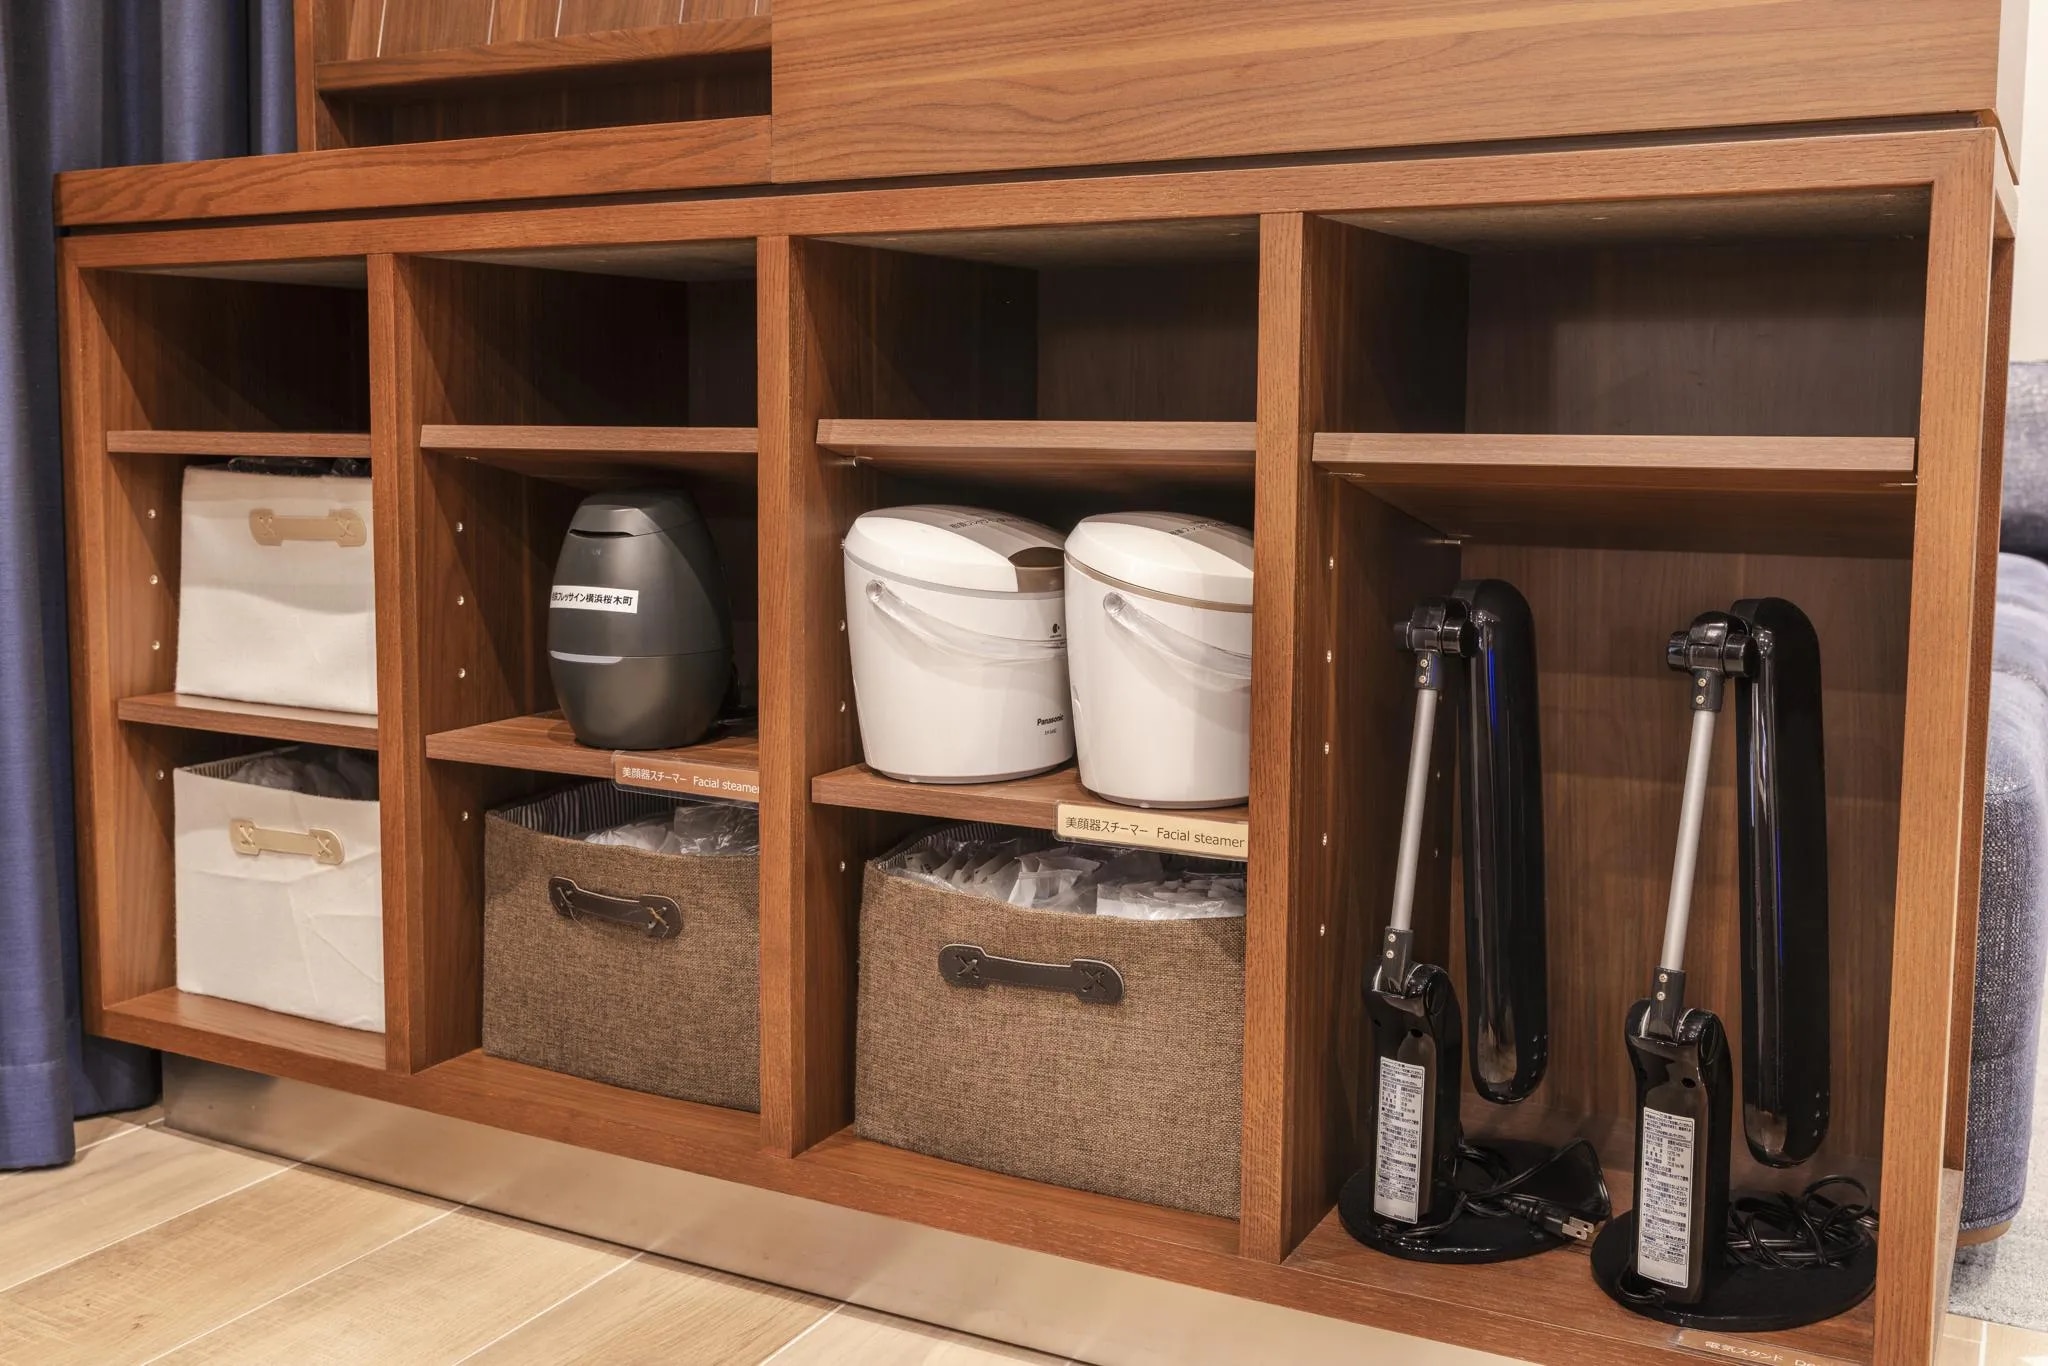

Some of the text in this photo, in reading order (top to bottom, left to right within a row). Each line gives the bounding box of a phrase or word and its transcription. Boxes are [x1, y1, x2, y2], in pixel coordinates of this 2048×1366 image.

[1037, 713, 1064, 726] Panasonic
[622, 767, 687, 784] 美顔器スチーマー
[693, 776, 719, 789] Facial
[1065, 816, 1149, 836] 美顔器スチーマー
[1156, 827, 1246, 848] Facial steamer
[1705, 1341, 1784, 1361] 電気スタンド
